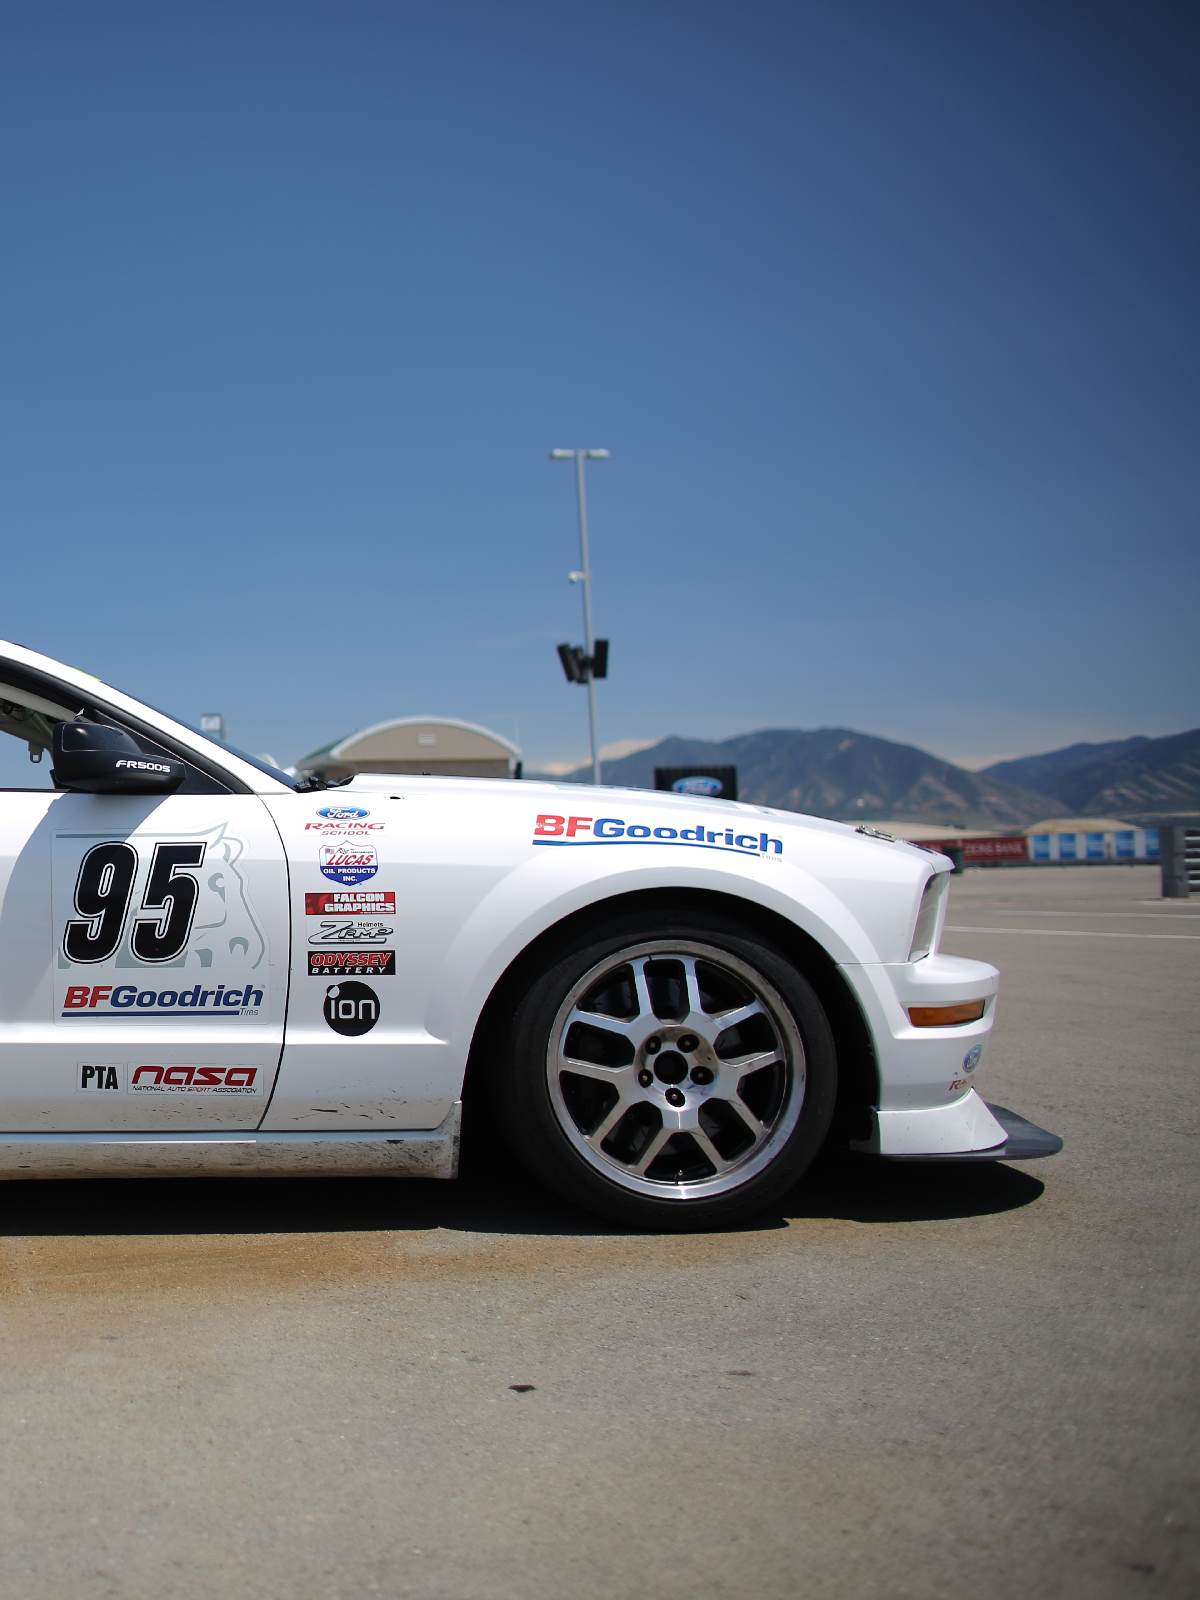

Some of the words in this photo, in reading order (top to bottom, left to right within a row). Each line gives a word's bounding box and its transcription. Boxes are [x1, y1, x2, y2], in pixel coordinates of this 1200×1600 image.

[115, 759, 171, 773] FR500S
[327, 807, 360, 819] Ford
[305, 822, 386, 830] RACING
[534, 815, 783, 854] BFGoodrich
[326, 854, 374, 866] LUCAS
[63, 841, 207, 964] 95
[333, 893, 384, 902] FALCON
[324, 902, 394, 912] GRAPHICS
[310, 952, 392, 967] ODYSSEY
[64, 984, 264, 1009] BFGoodrich
[327, 984, 376, 1020] ion
[240, 1008, 259, 1016] Tires
[81, 1065, 119, 1090] PTA
[131, 1065, 258, 1087] nasa
